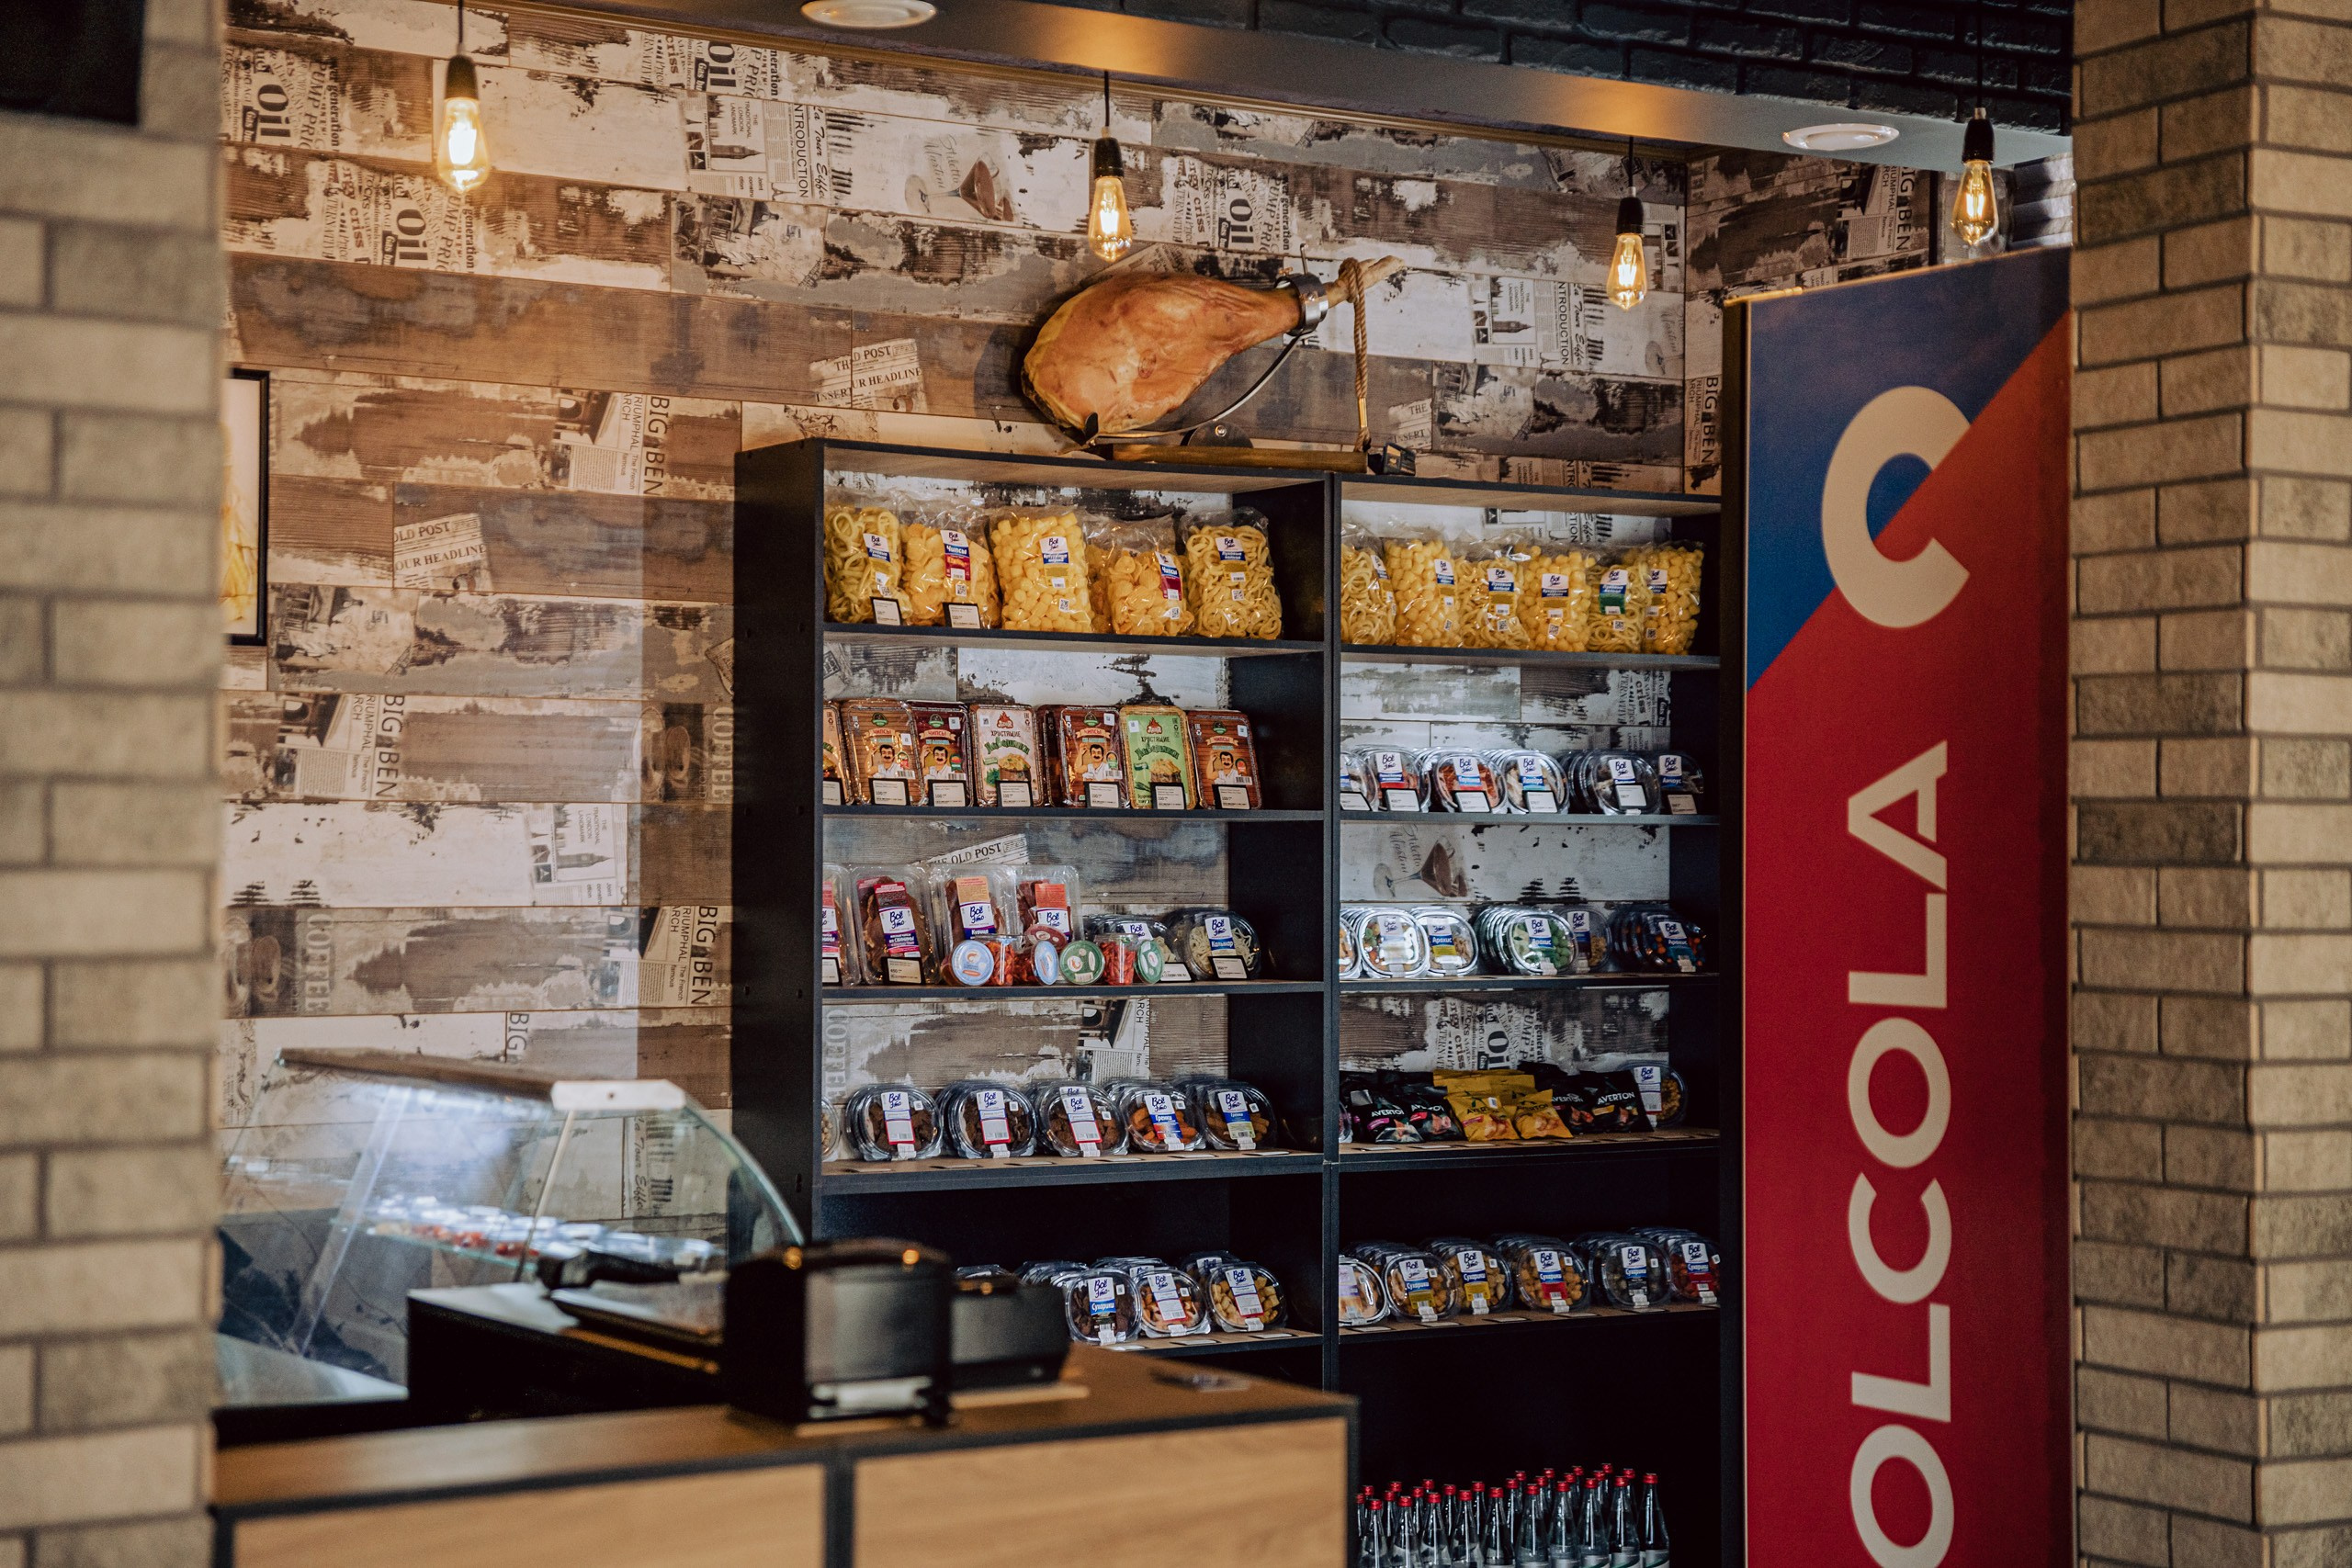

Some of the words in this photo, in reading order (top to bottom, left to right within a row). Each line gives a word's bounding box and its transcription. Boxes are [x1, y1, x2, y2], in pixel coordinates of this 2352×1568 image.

[665, 37, 679, 73] criss
[707, 42, 737, 87] Oil
[258, 84, 291, 138] Oil
[326, 85, 343, 147] generation
[794, 104, 808, 198] NTRODUCTION
[815, 126, 825, 157] Tour
[349, 207, 366, 249] criss
[1194, 197, 1205, 232] criss
[1230, 198, 1254, 243] Oil
[1281, 197, 1292, 250] generation
[1896, 209, 1912, 251] BEN
[396, 209, 429, 261] Oil
[463, 209, 480, 268] generation
[1558, 282, 1570, 365] NTRODUCTION
[864, 345, 890, 359] POST
[1408, 404, 1429, 415] THE
[1705, 377, 1719, 410] BIG
[649, 396, 670, 434] BIG
[1702, 425, 1716, 462] BEN
[620, 453, 628, 476] famous
[644, 451, 665, 496] BEN
[419, 521, 450, 536] POST
[381, 695, 404, 733] BIG
[1635, 681, 1646, 714] criss
[712, 706, 734, 797] COFFEE
[376, 751, 400, 797] BEN
[975, 843, 1001, 858] POST
[696, 906, 718, 942] BIG
[669, 964, 677, 987] famous
[691, 961, 713, 1005] BEN
[508, 1013, 529, 1052] BIG
[1454, 1035, 1465, 1069] criss
[1597, 1091, 1635, 1105] AVERTON
[1091, 1302, 1114, 1311] Сухарики
